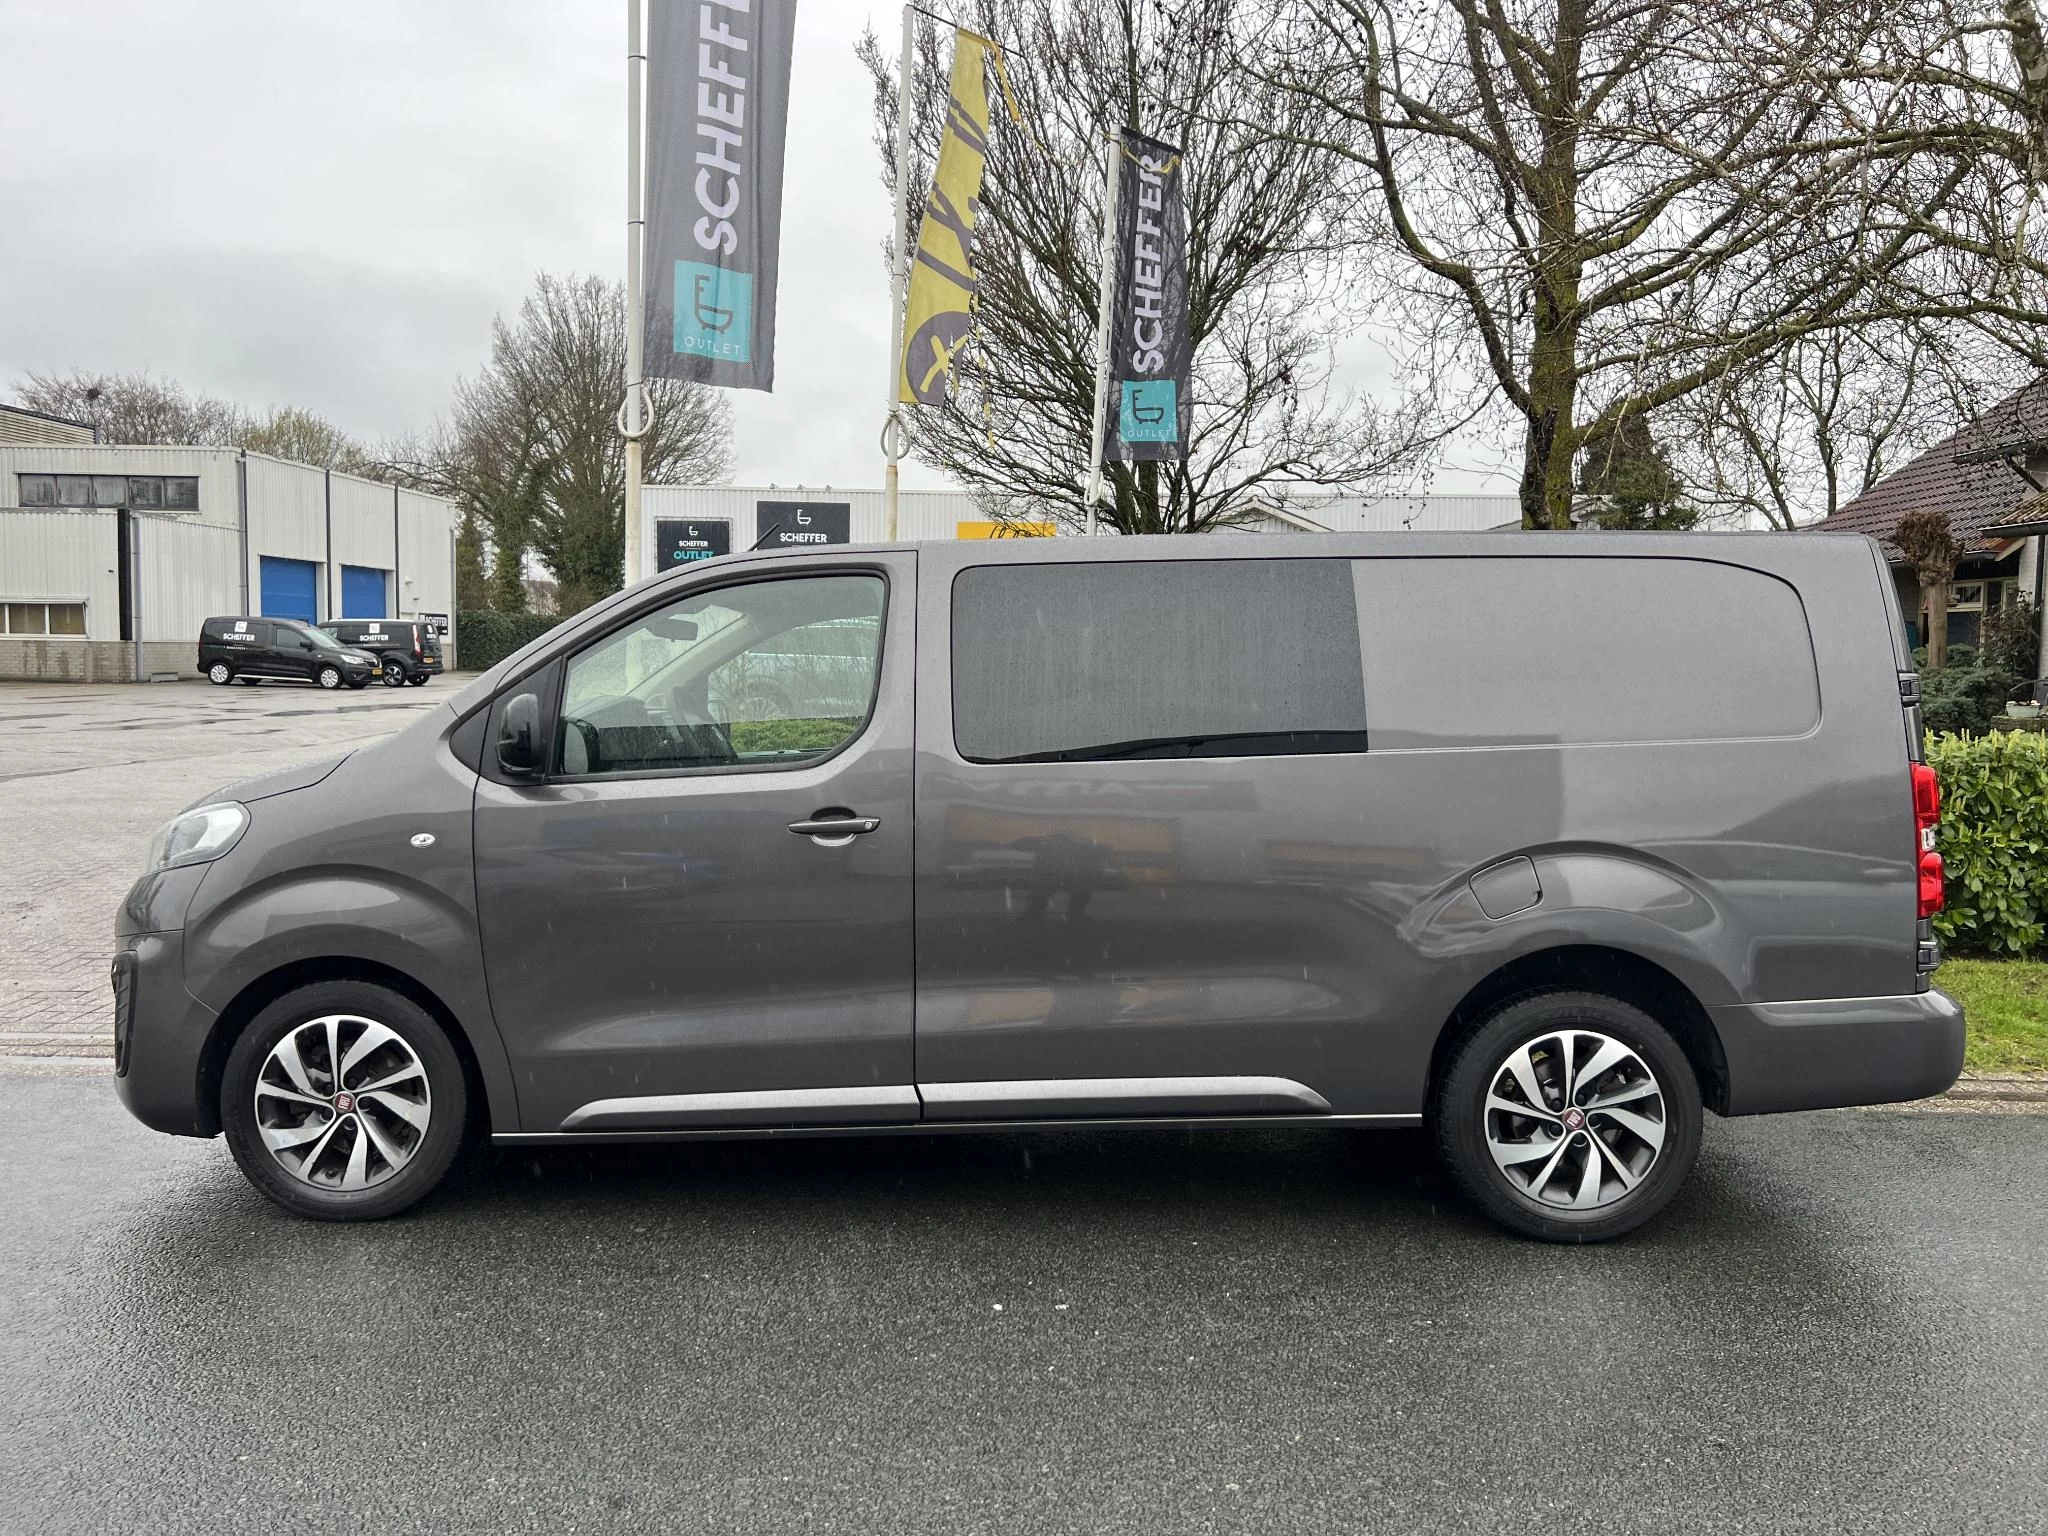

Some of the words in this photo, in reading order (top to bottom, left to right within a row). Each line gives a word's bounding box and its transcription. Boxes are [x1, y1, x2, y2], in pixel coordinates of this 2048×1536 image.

[1132, 154, 1165, 373] SCHEFFER
[684, 335, 742, 356] OUTLET
[1127, 428, 1172, 439] OUTLET
[779, 532, 828, 543] SCHEFFER
[678, 540, 709, 548] SCHEFFER
[673, 550, 714, 561] OUTLET
[222, 632, 256, 642] SCHEFFER
[359, 634, 389, 642] SCHEFFER
[338, 1094, 351, 1110] FIAT
[1566, 1111, 1582, 1128] FIAT
